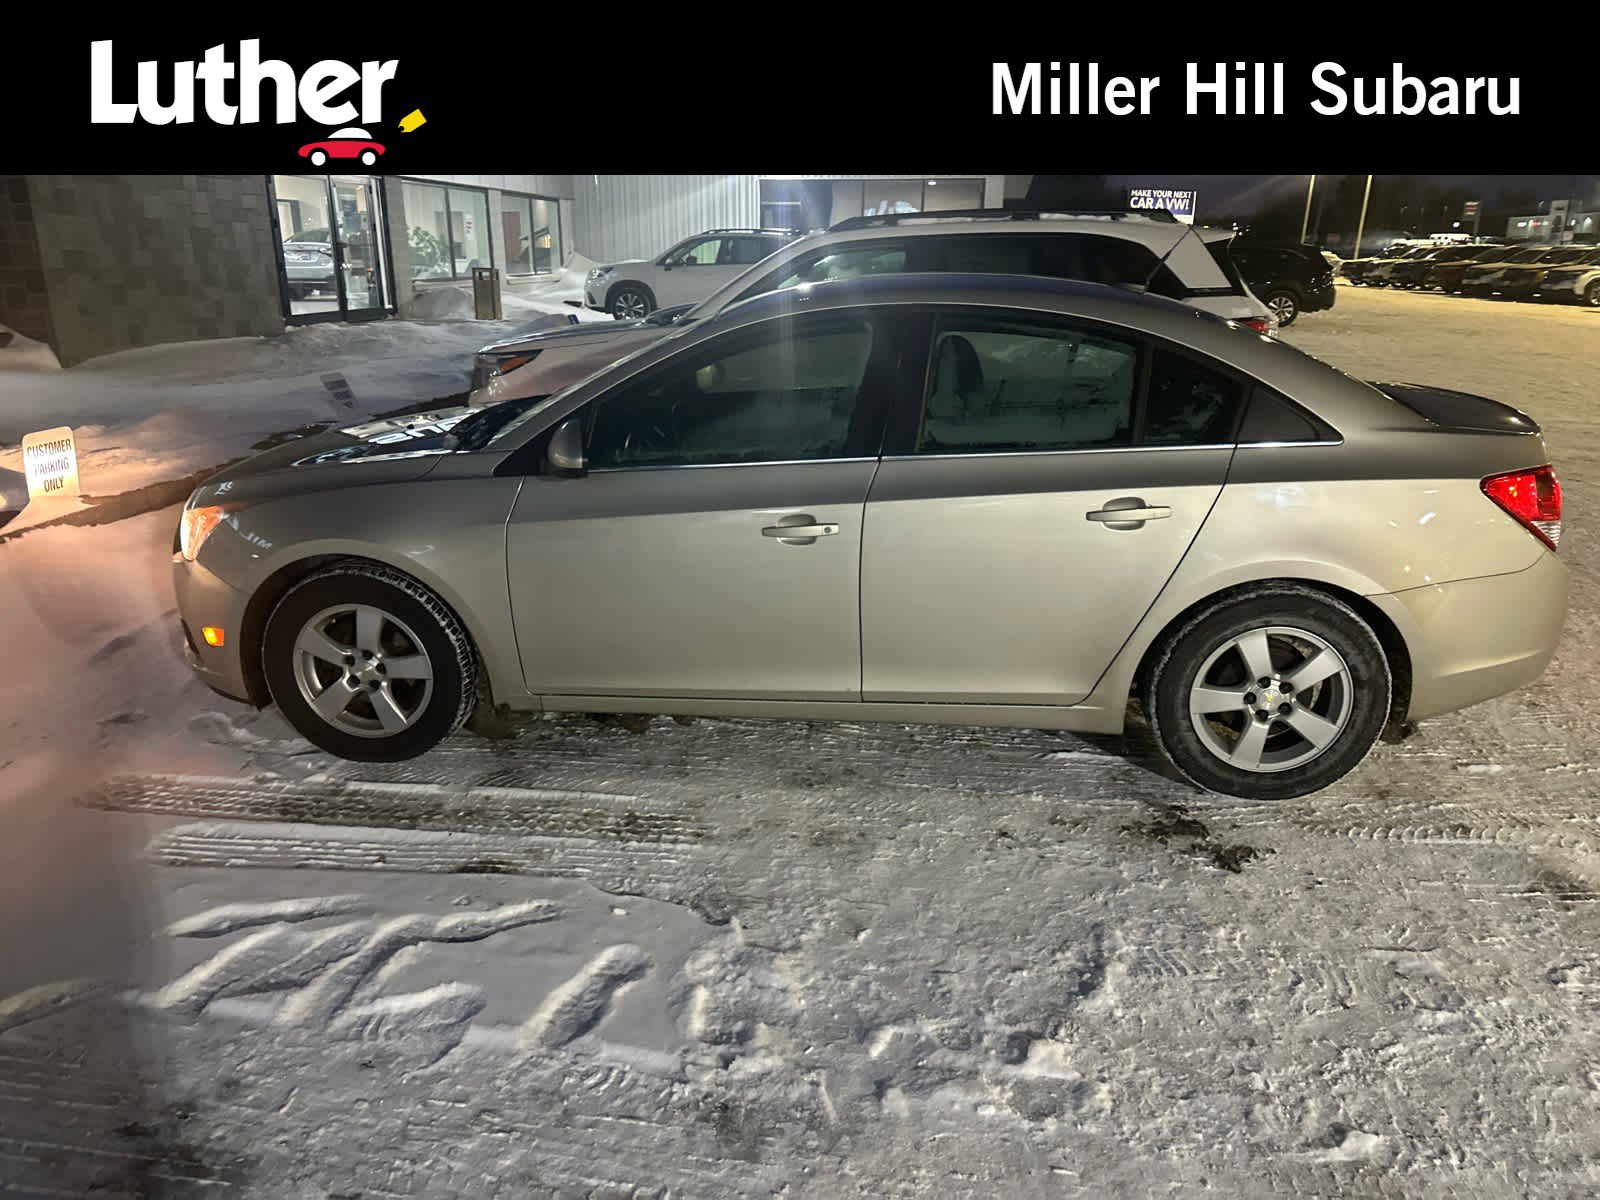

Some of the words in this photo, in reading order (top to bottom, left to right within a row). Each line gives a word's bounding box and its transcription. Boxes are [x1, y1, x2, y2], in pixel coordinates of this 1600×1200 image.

[1152, 190, 1172, 198] YOUR
[1173, 190, 1192, 199] NEXT
[1130, 197, 1153, 209] CAR
[1155, 198, 1164, 209] A
[1165, 198, 1189, 210] VW!
[27, 438, 72, 457] CUSTOMER
[34, 457, 70, 476] PARKING
[43, 476, 64, 493] ONLY
